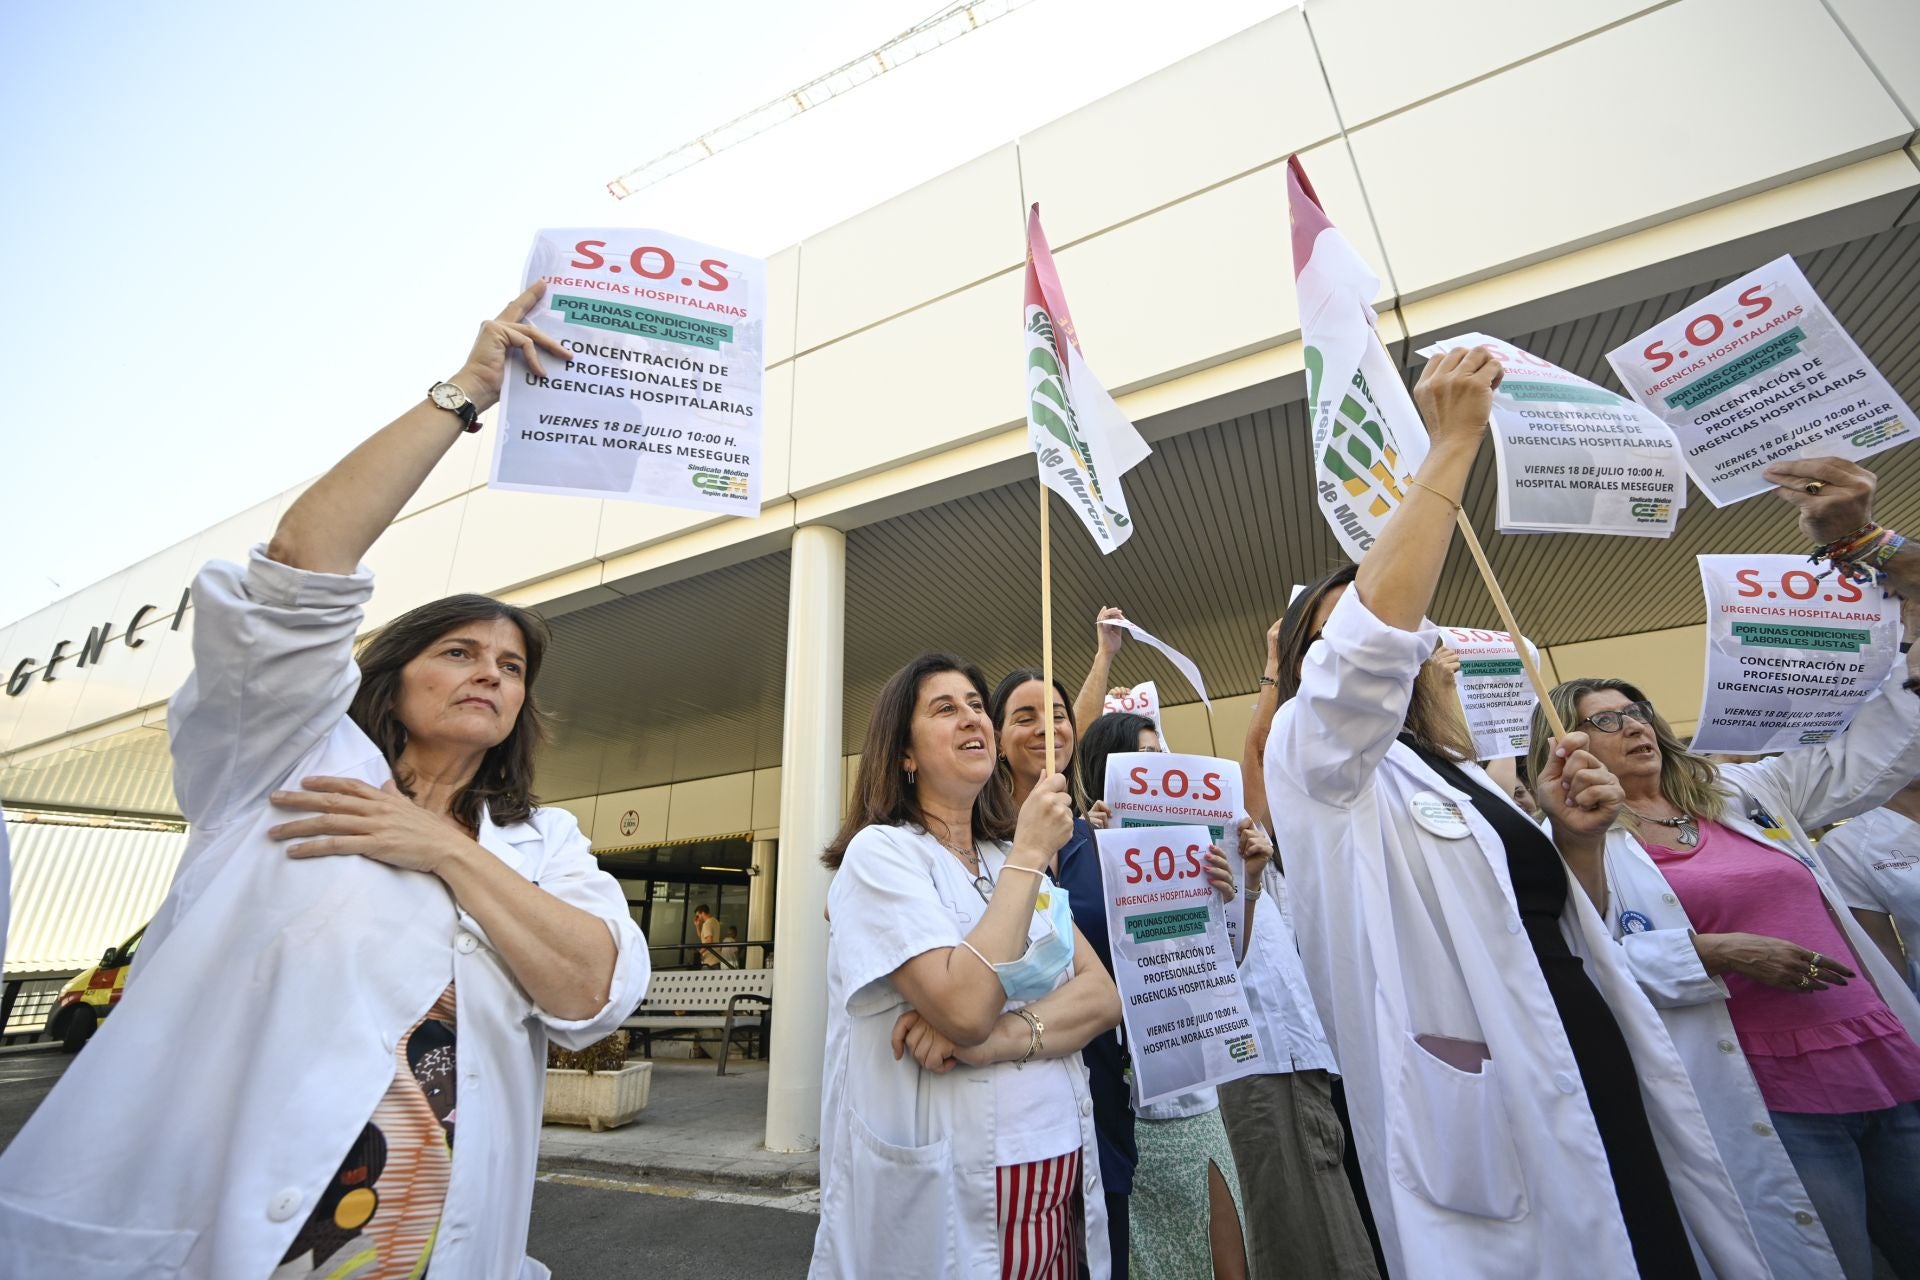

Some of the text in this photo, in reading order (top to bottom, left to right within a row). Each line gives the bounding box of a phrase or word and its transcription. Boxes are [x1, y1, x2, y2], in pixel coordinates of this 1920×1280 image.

[570, 240, 728, 292] S.O.S
[542, 276, 748, 318] URGENCIAS HOSPITALARIAS
[558, 299, 728, 338] POR UNAS CONDICIONES
[571, 312, 714, 346] LABORALES JUSTAS
[1644, 285, 1772, 372] S.O.S
[560, 338, 728, 376] CONCENTRACIÓN DE
[1645, 306, 1804, 398] URGENCIAS HOSPITALARIAS
[565, 360, 722, 394] PROFESIONALES DE
[1670, 332, 1800, 405] POR UNAS CONDICIONES
[1684, 347, 1794, 407] LABORALES JUSTAS
[526, 373, 754, 417] URGENCIAS HOSPITALARIAS
[1694, 358, 1822, 426] CONCENTRACIÓN DE
[1706, 372, 1827, 434] PROFESIONALES DE
[1520, 410, 1638, 422] CONCENTRACIÓN DE
[1529, 422, 1642, 434] PROFESIONALES DE
[1690, 369, 1867, 458] URGENCIAS HOSPITALARIAS
[539, 414, 737, 448] VIERNES 18 DE JULIO 10:00 H.
[1508, 436, 1672, 448] URGENCIAS HOSPITALARIAS
[1712, 402, 1893, 484] HOSPITAL MORALES MESEGUER
[1715, 398, 1870, 472] VIERNES 18 DE JULIO 10:00 H.
[521, 430, 750, 466] HOSPITAL MORALES MESEGUER
[688, 464, 748, 478] Sindicato Médico
[1516, 480, 1674, 492] HOSPITAL MORALES MESEGUER
[1524, 466, 1664, 478] VIERNES 18 DE JULIO 10:00 H.
[1040, 448, 1064, 468] de
[1058, 467, 1108, 540] Murcia
[1319, 481, 1338, 502] de
[1334, 504, 1376, 552] Murc
[1736, 569, 1862, 602] S.O.S
[1721, 605, 1880, 622] URGENCIAS HOSPITALARIAS
[1736, 626, 1866, 641] POR UNAS CONDICIONES
[1746, 635, 1855, 648] LABORALES JUSTAS
[1740, 656, 1865, 672] CONCENTRACIÓN DE
[1744, 670, 1856, 686] PROFESIONALES DE
[1464, 682, 1513, 690] CONCENTRACIÓN
[1718, 682, 1869, 698] URGENCIAS HOSPITALARIAS
[1486, 700, 1532, 708] HOSPITALARIAS
[1724, 708, 1762, 718] VIERNES
[1764, 710, 1776, 718] 18
[1787, 711, 1813, 720] JULIO
[1712, 718, 1756, 728] HOSPITAL
[1760, 720, 1802, 728] MORALES
[1129, 766, 1221, 801] S.O.S
[1114, 802, 1232, 818] URGENCIAS HOSPITALARIAS
[1124, 844, 1201, 884] S.O.S
[1116, 886, 1212, 907] URGENCIAS HOSPITALARIAS
[1128, 910, 1207, 928] POR UNAS CONDICIONES
[1136, 922, 1202, 939] LABORALES JUSTAS
[1138, 945, 1216, 968] CONCENTRACIÓN DE
[1144, 961, 1217, 984] PROFESIONALES DE
[1130, 974, 1236, 1006] URGENCIAS HOSPITALARIAS
[1143, 1019, 1249, 1055] HOSPITAL MORALES MESEGUER
[1147, 1006, 1239, 1037] VIERNES 18 DE JULIO 10:00 H.
